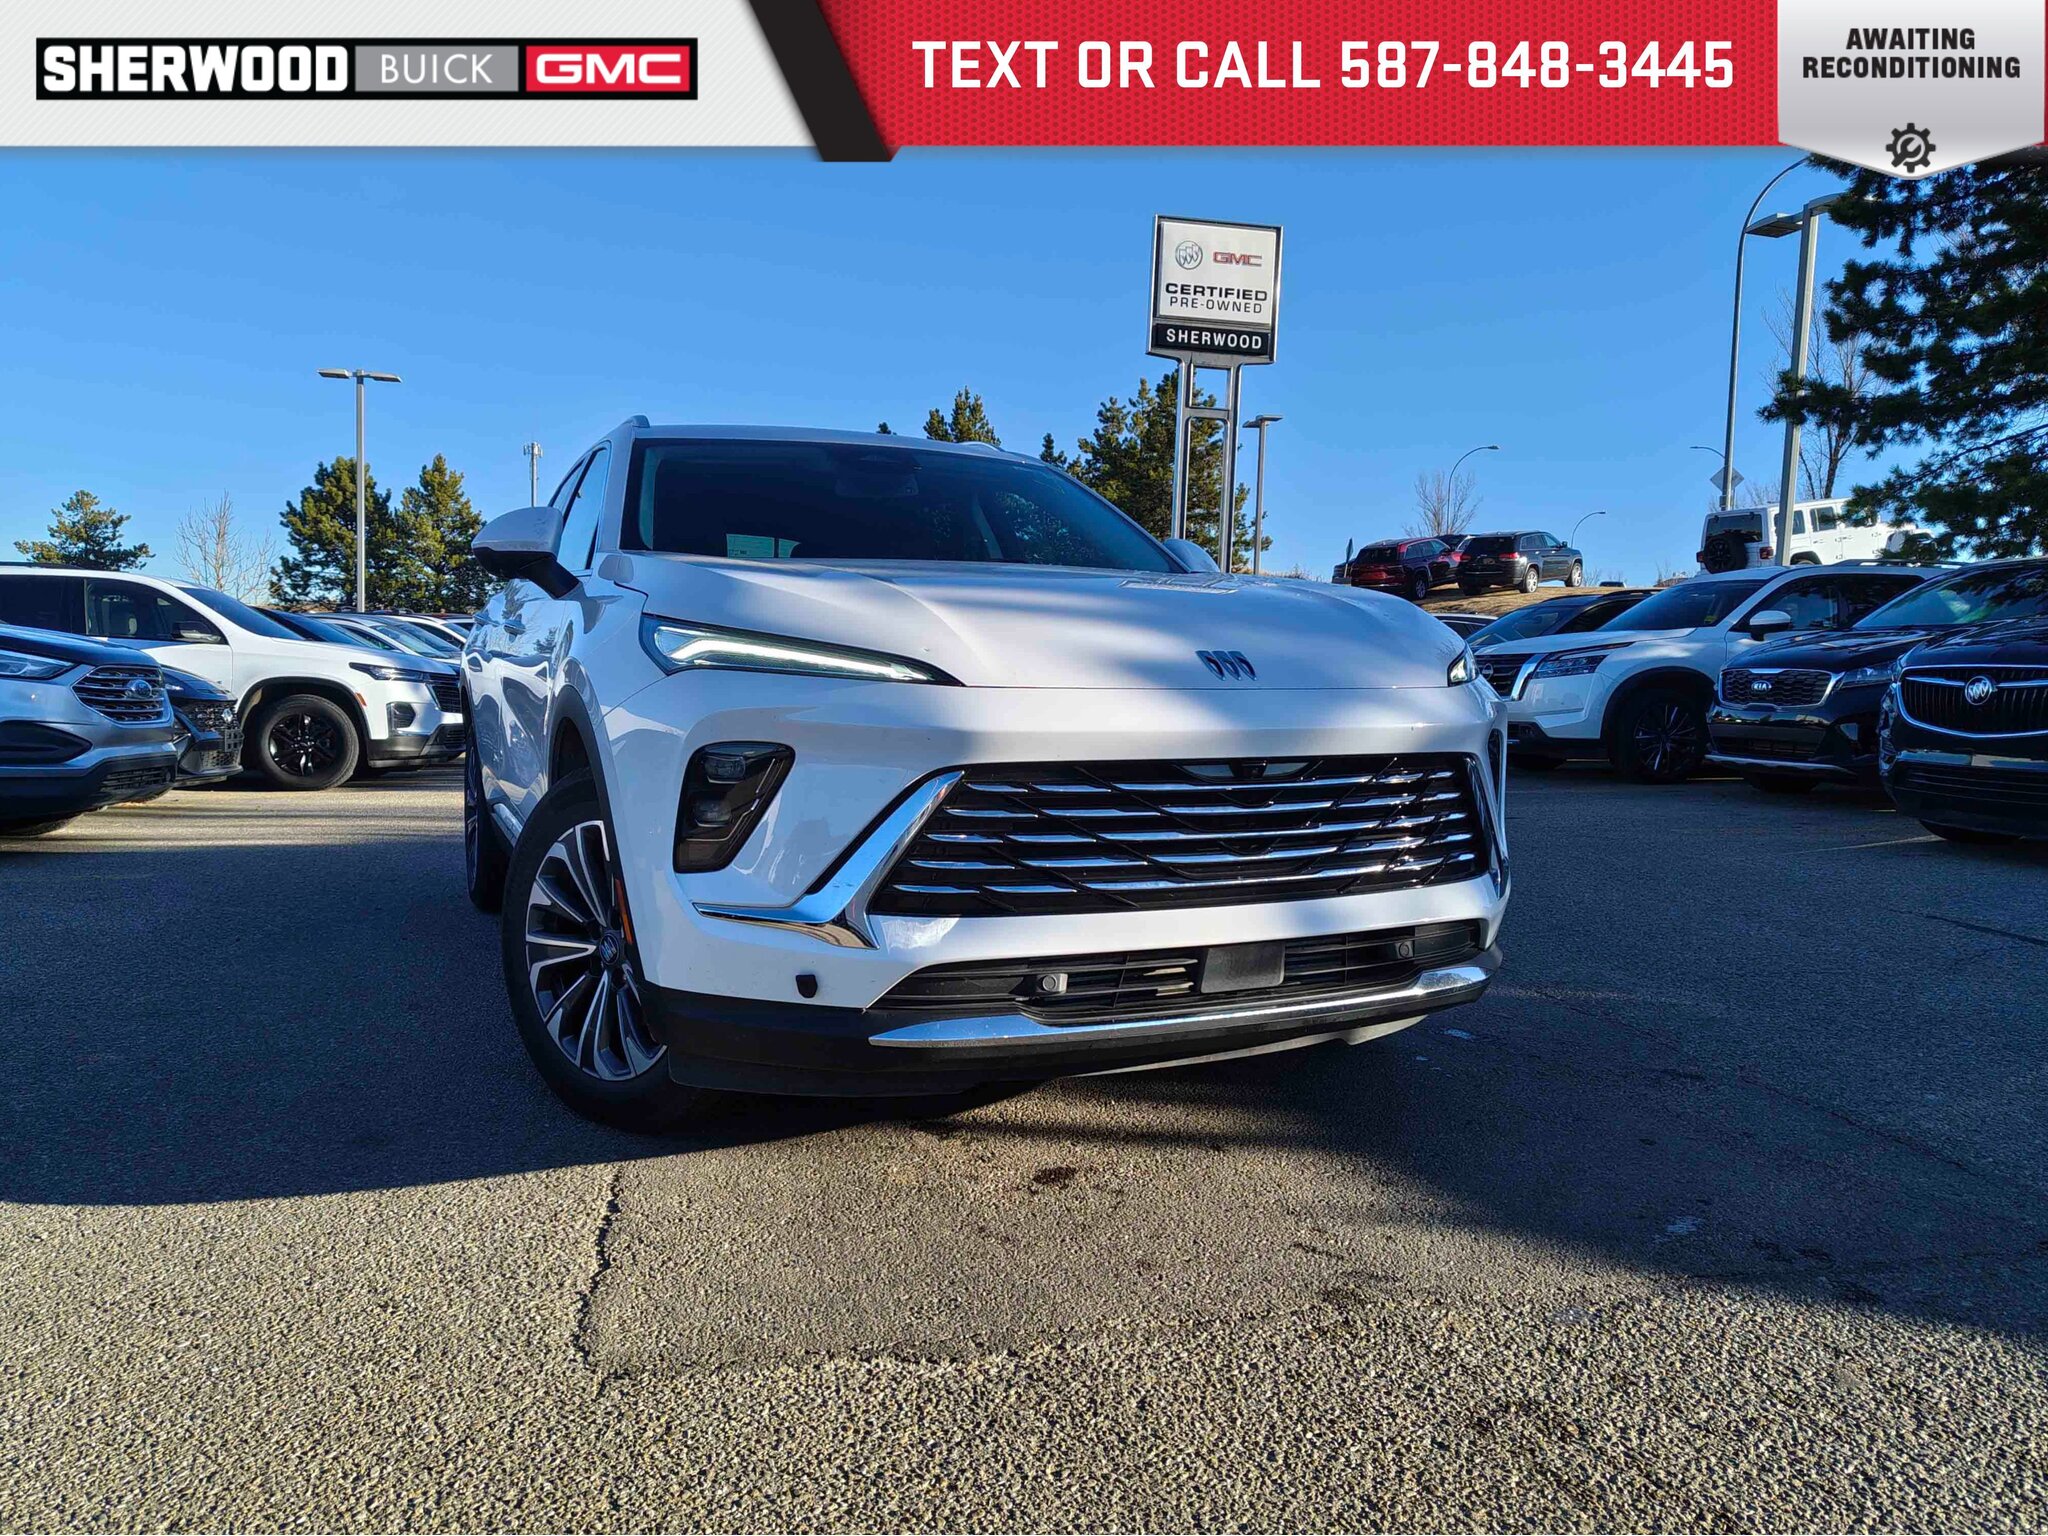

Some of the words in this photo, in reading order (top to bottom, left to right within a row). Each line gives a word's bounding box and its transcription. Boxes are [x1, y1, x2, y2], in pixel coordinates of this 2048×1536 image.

[1213, 251, 1262, 267] GMC
[1165, 283, 1268, 301] CERTIFIED
[1170, 296, 1262, 314] PRE-OWNED
[1166, 328, 1262, 349] SHERWOOD
